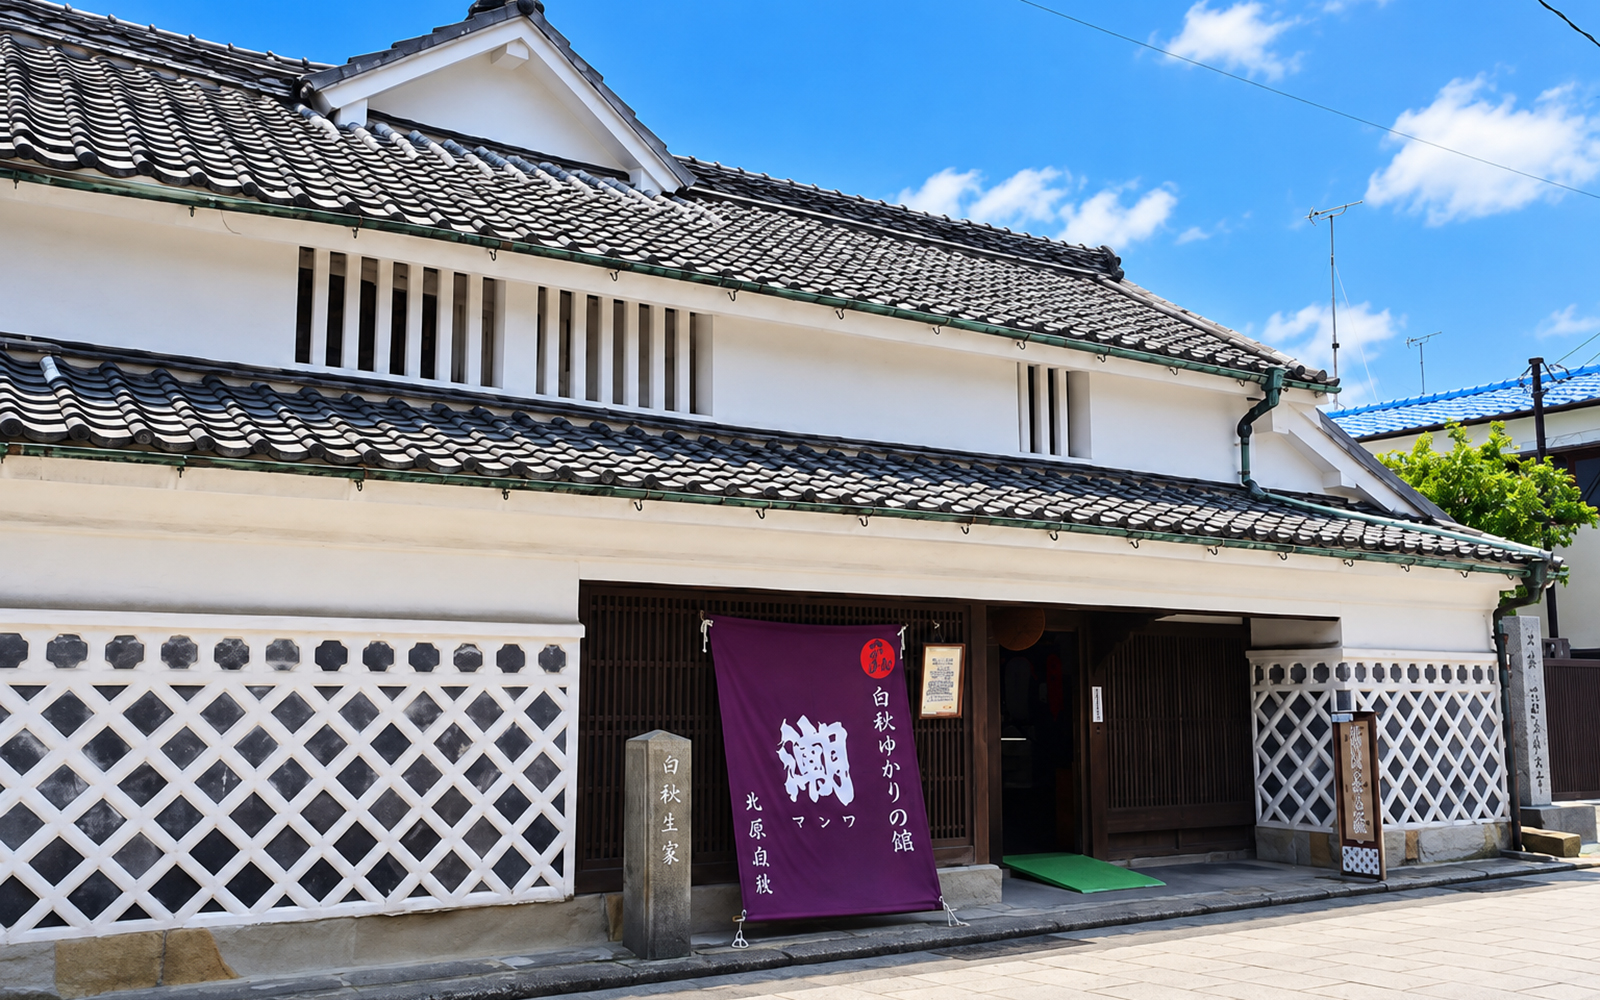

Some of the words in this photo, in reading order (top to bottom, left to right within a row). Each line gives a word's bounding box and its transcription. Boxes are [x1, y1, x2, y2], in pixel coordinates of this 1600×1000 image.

[660, 755, 681, 866] 白秋生家
[873, 686, 915, 853] 白秋ゆかりの館
